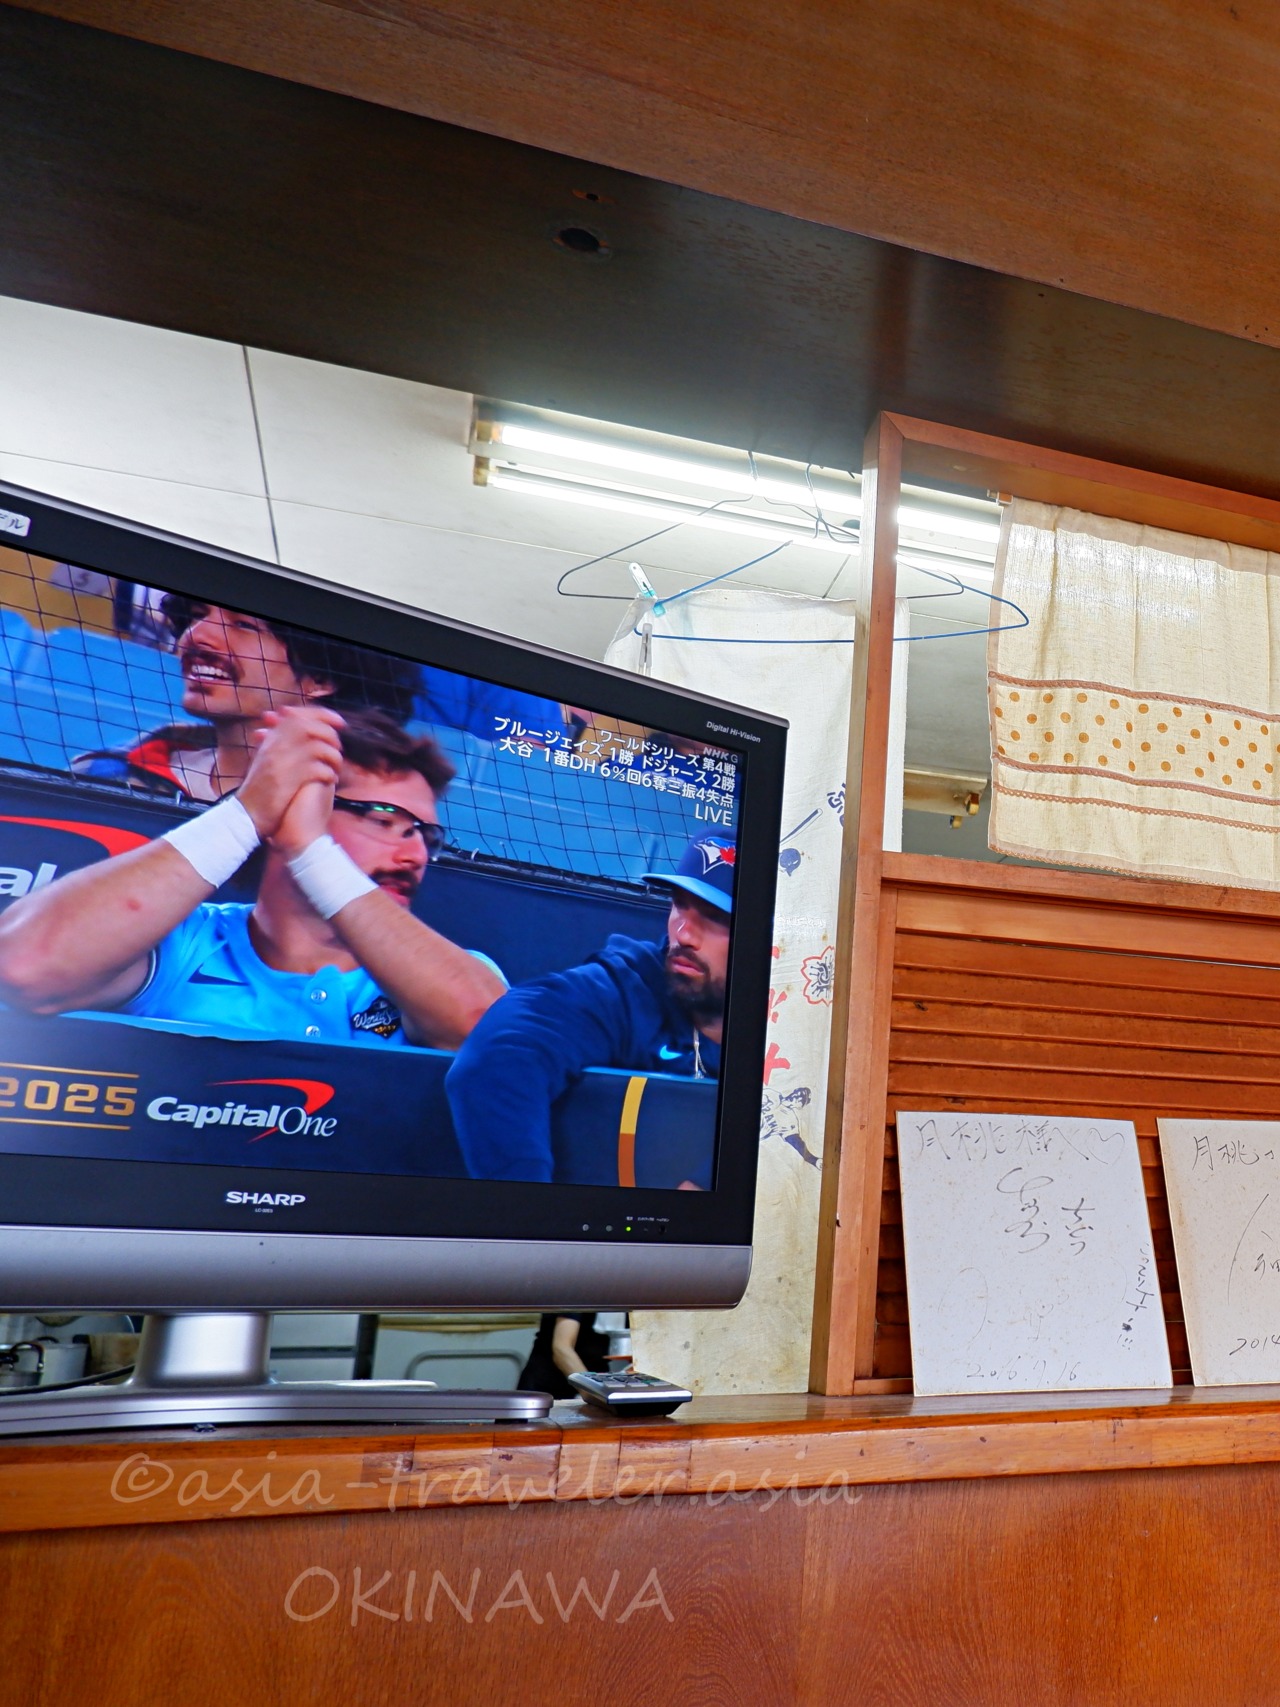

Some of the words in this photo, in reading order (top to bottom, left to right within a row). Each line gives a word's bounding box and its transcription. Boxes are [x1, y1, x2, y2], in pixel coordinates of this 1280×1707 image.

[706, 720, 729, 734] Digital
[730, 725, 761, 743] Hi-Vision
[493, 716, 604, 757] ブルージェイズ
[610, 747, 634, 765] 1勝
[642, 755, 708, 785] ドジャース
[713, 775, 736, 793] 2勝
[499, 736, 533, 758] 大谷
[543, 747, 596, 774] 1番DH
[600, 729, 700, 767] ワールドシリーズ
[702, 757, 736, 778] 第4戦
[703, 746, 728, 761] NHK
[695, 803, 733, 827] LIVE
[0, 1079, 138, 1116] 2025
[225, 1191, 307, 1206] SHARP
